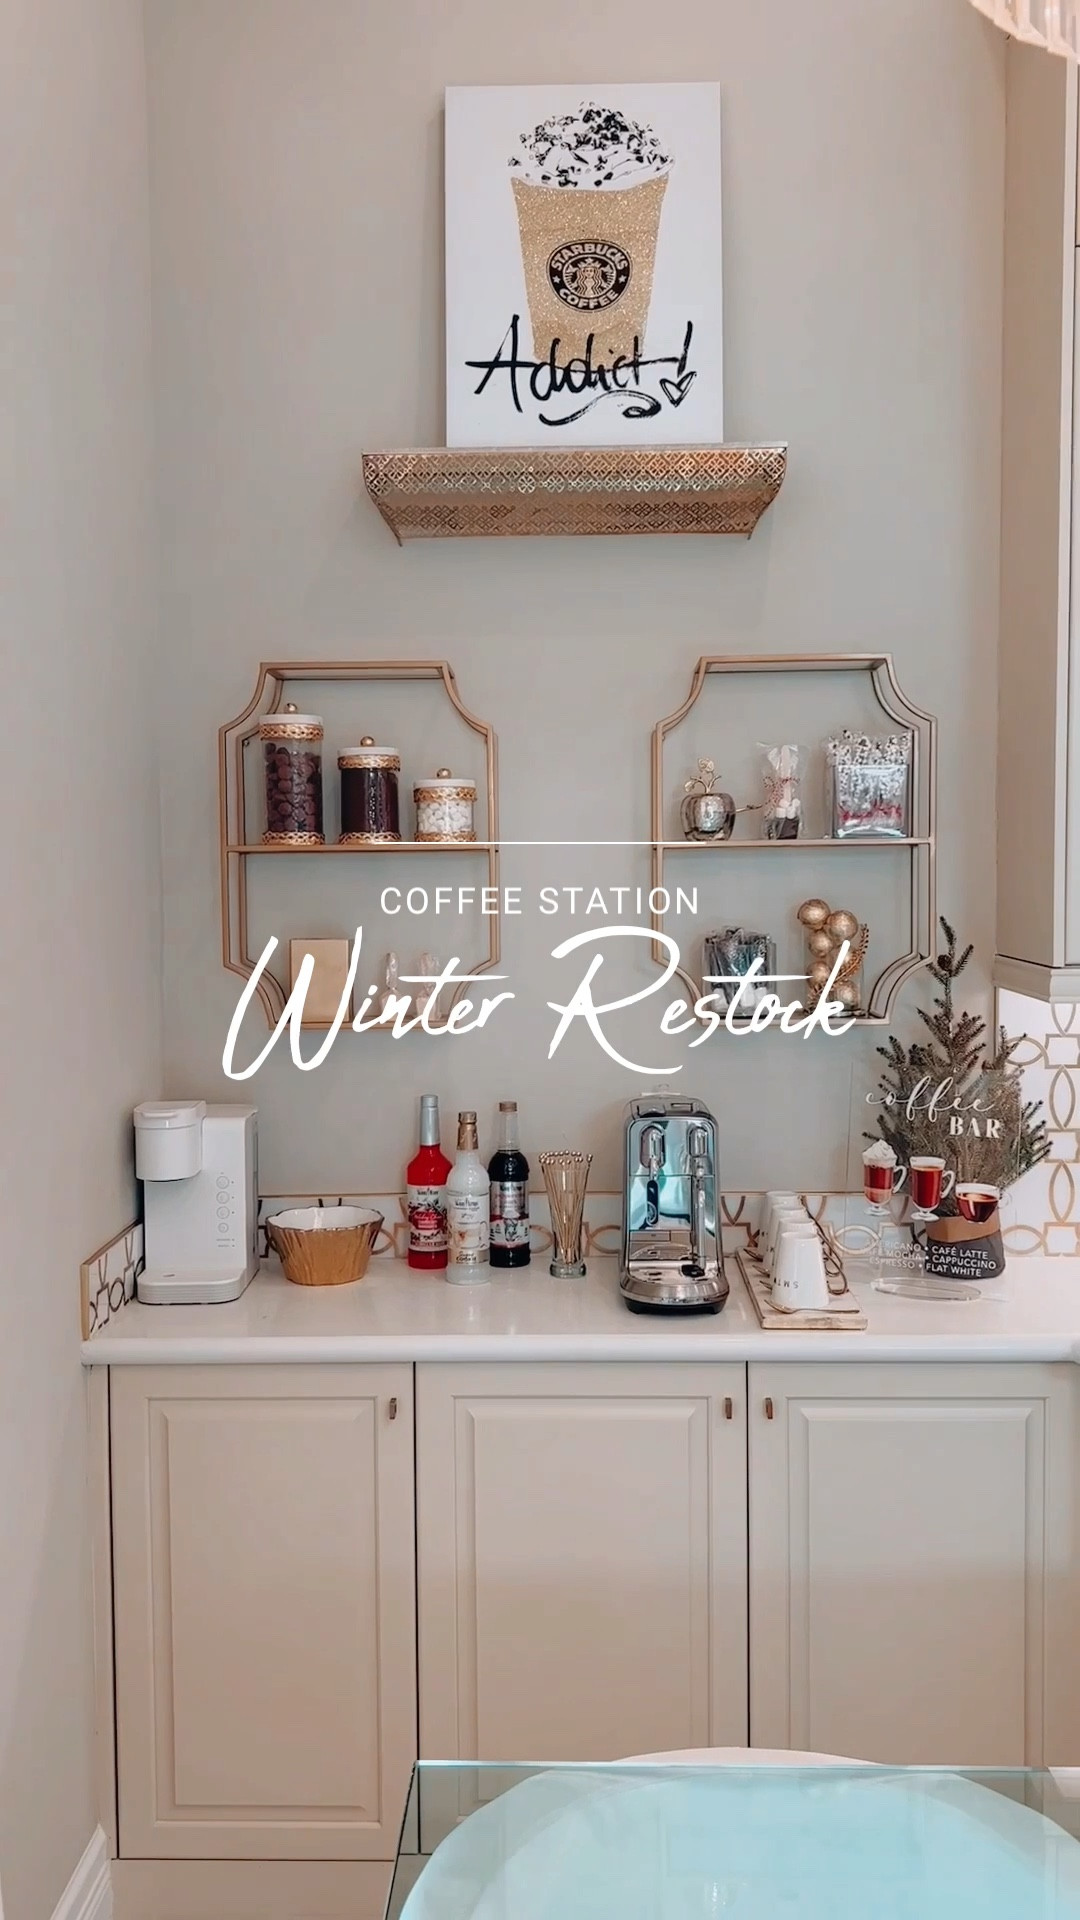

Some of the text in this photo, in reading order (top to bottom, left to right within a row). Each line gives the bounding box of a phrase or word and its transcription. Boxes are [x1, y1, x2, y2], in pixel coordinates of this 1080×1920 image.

[550, 243, 628, 270] STARBUCKS
[559, 288, 620, 309] COFFEE
[865, 1075, 996, 1122] coffee
[949, 1116, 1001, 1139] BAR
[887, 1250, 922, 1261] MOCHA
[932, 1254, 997, 1269] CAPPUCCINO
[931, 1245, 957, 1255] CAFÉ
[959, 1250, 989, 1260] LATTE
[869, 1256, 982, 1277] ESPRESSO FLAT WHITE
